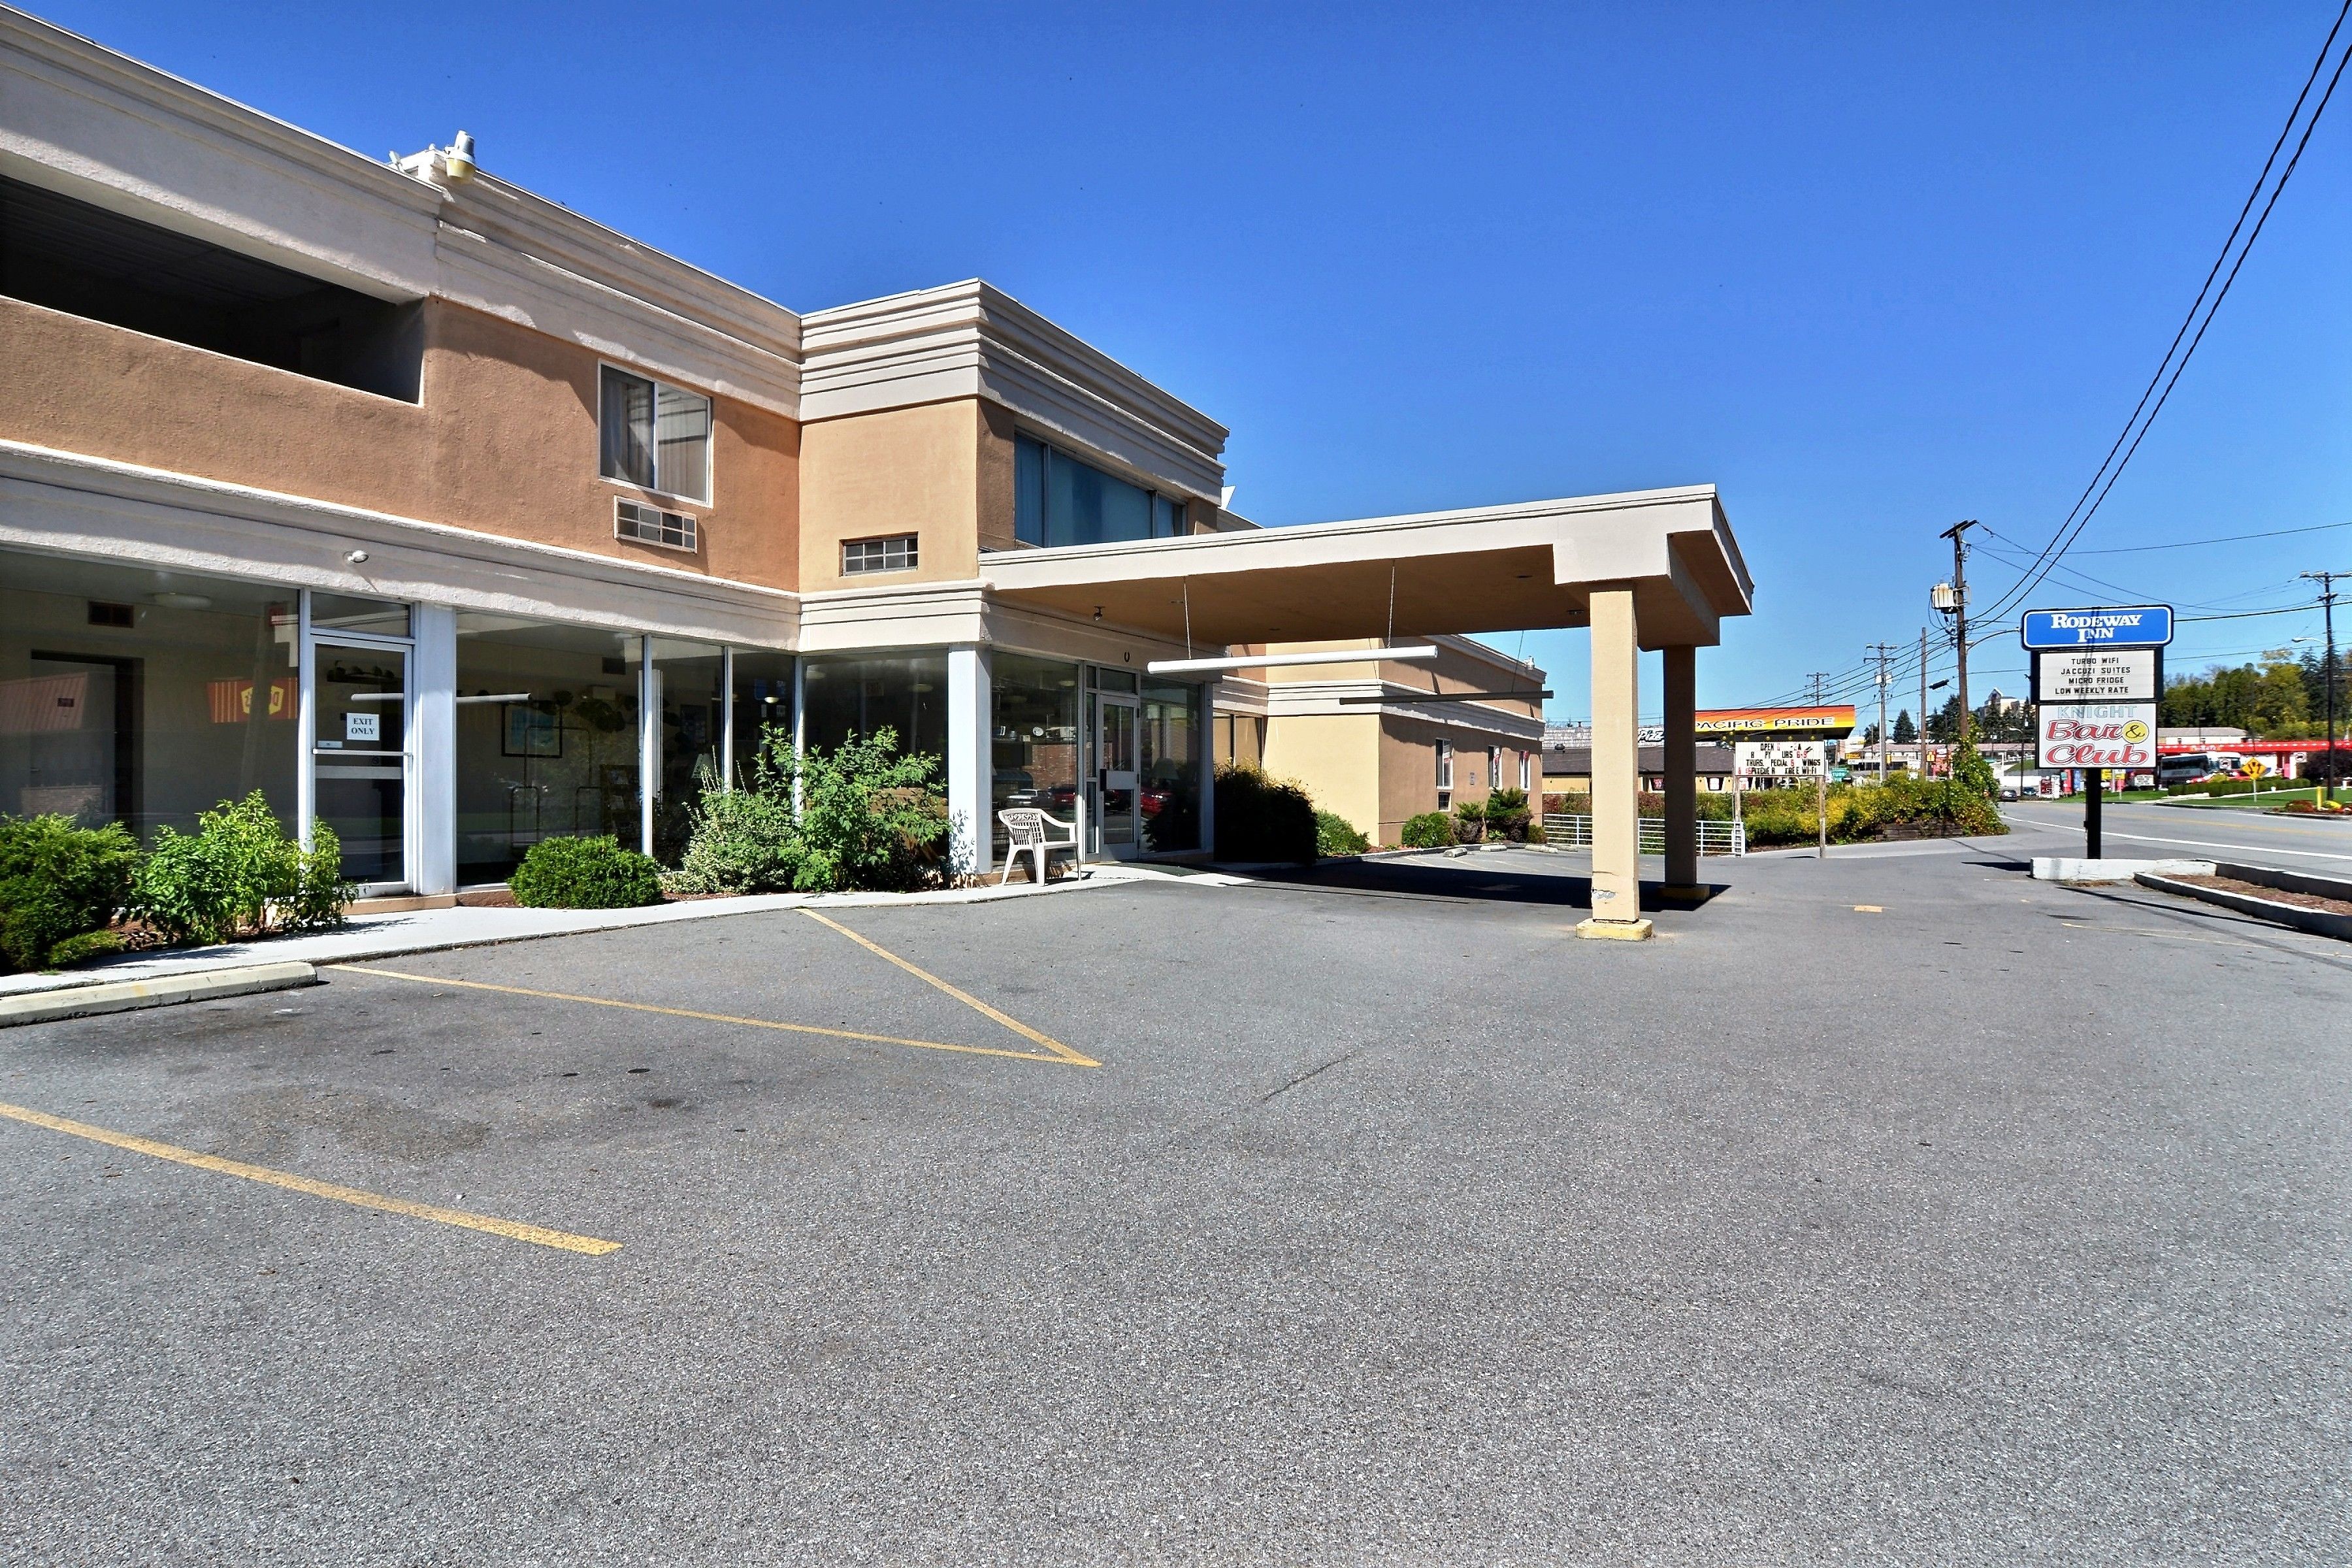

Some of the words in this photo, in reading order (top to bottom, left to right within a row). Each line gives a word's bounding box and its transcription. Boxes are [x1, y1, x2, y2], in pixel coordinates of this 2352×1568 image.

[2051, 613, 2143, 629] RODEWAY
[2077, 627, 2115, 642] INN
[2058, 706, 2138, 718] KNIGHT
[1696, 720, 1763, 729] ACIFIC
[1774, 718, 1834, 727] PRIDE
[2046, 719, 2123, 741] Bar
[2125, 725, 2146, 739] &
[2045, 743, 2149, 766] Club
